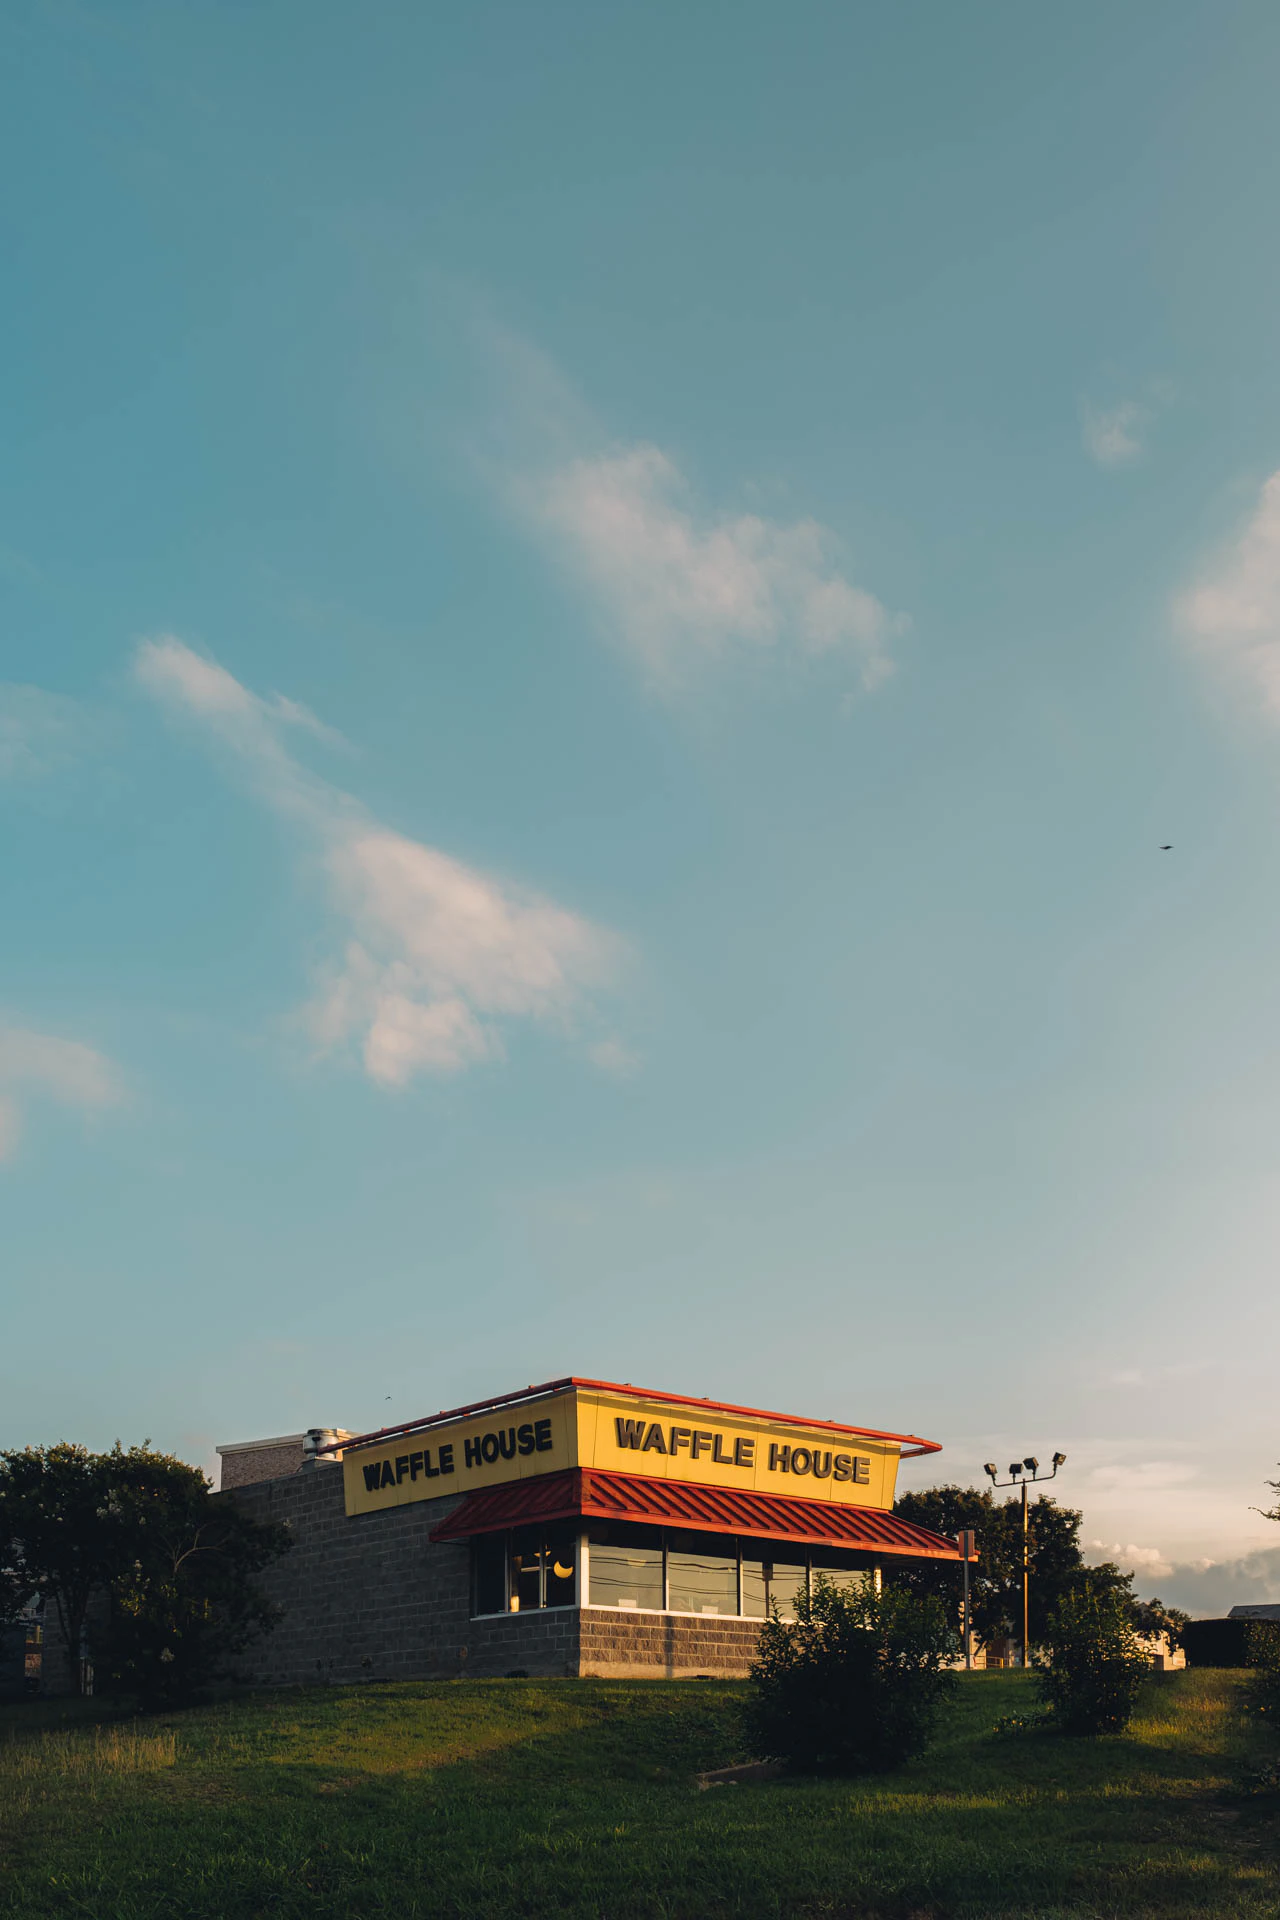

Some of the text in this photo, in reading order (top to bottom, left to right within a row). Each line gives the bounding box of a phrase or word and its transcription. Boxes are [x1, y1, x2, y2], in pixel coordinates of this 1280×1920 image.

[363, 1419, 552, 1491] WAFFLE HOUSE
[615, 1418, 870, 1484] WAFFLE HOUSE
